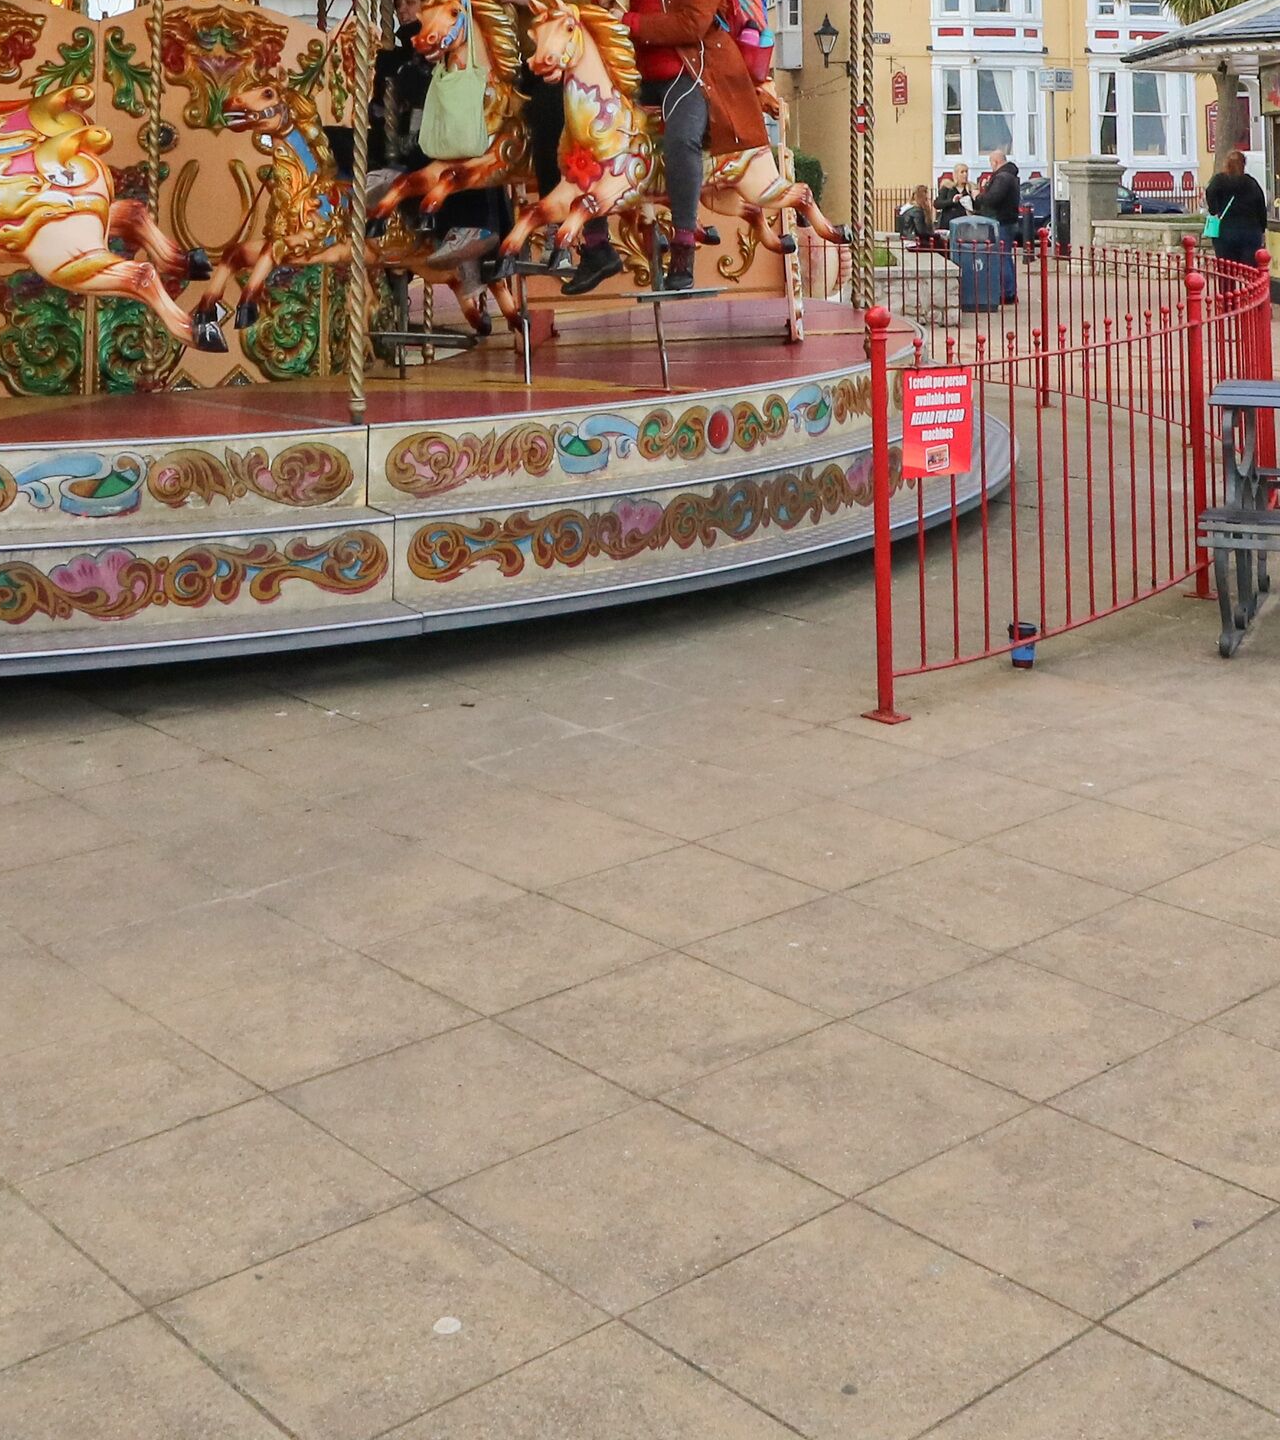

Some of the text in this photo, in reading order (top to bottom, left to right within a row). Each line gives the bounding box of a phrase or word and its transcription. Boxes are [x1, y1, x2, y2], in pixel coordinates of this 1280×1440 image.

[908, 375, 968, 390] 1 credit per person
[915, 392, 961, 407] available from
[911, 408, 965, 426] RELOAD FUN CARD
[921, 426, 954, 442] machines
